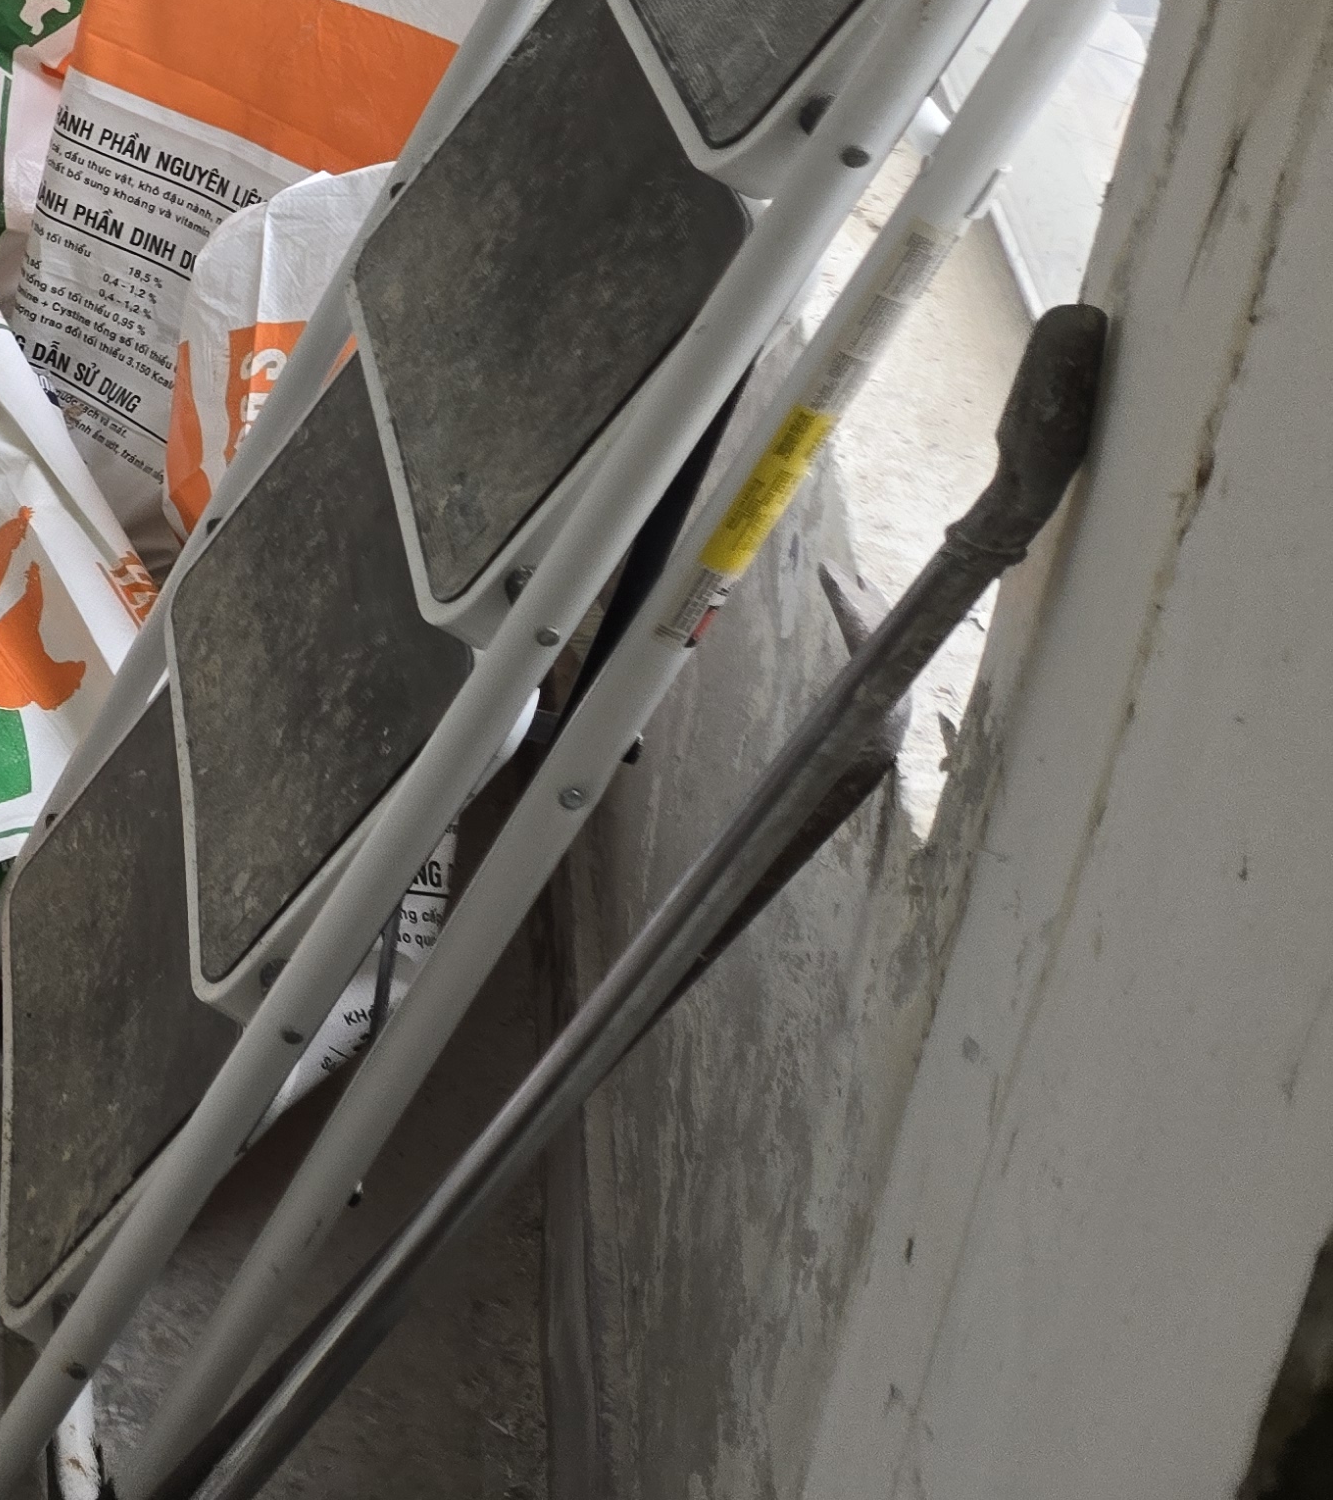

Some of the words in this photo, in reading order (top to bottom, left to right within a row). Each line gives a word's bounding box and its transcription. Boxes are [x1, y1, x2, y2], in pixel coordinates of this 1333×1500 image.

[87, 160, 111, 177] thực
[115, 173, 132, 185] vật,
[137, 181, 159, 196] khô
[163, 191, 185, 206] đậu
[186, 202, 212, 219] nành,
[99, 129, 150, 163] PHẦN
[156, 152, 229, 196] NGUYÊN
[73, 204, 123, 238] PHẦN
[129, 228, 176, 260] DINH
[84, 177, 110, 196] sung
[113, 189, 155, 214] khoáng
[157, 205, 173, 219] và
[175, 216, 210, 237] vitamin
[46, 231, 62, 245] tối
[64, 240, 91, 258] thiểu
[151, 277, 164, 289] %
[51, 283, 65, 297] số
[65, 291, 82, 305] tối
[83, 299, 110, 318] thiểu
[135, 324, 147, 336] %
[140, 308, 153, 320] %
[146, 292, 158, 304] %
[38, 315, 63, 331] trao
[83, 331, 97, 347] tối
[99, 343, 125, 362] thiểu
[126, 356, 151, 376] 3.150
[52, 301, 91, 327] Cystine
[93, 321, 117, 341] tổng
[118, 333, 134, 347] số
[134, 340, 150, 355] tối
[32, 340, 70, 372] DẪN
[73, 362, 100, 387] SỬ
[96, 378, 141, 412] DỤNG
